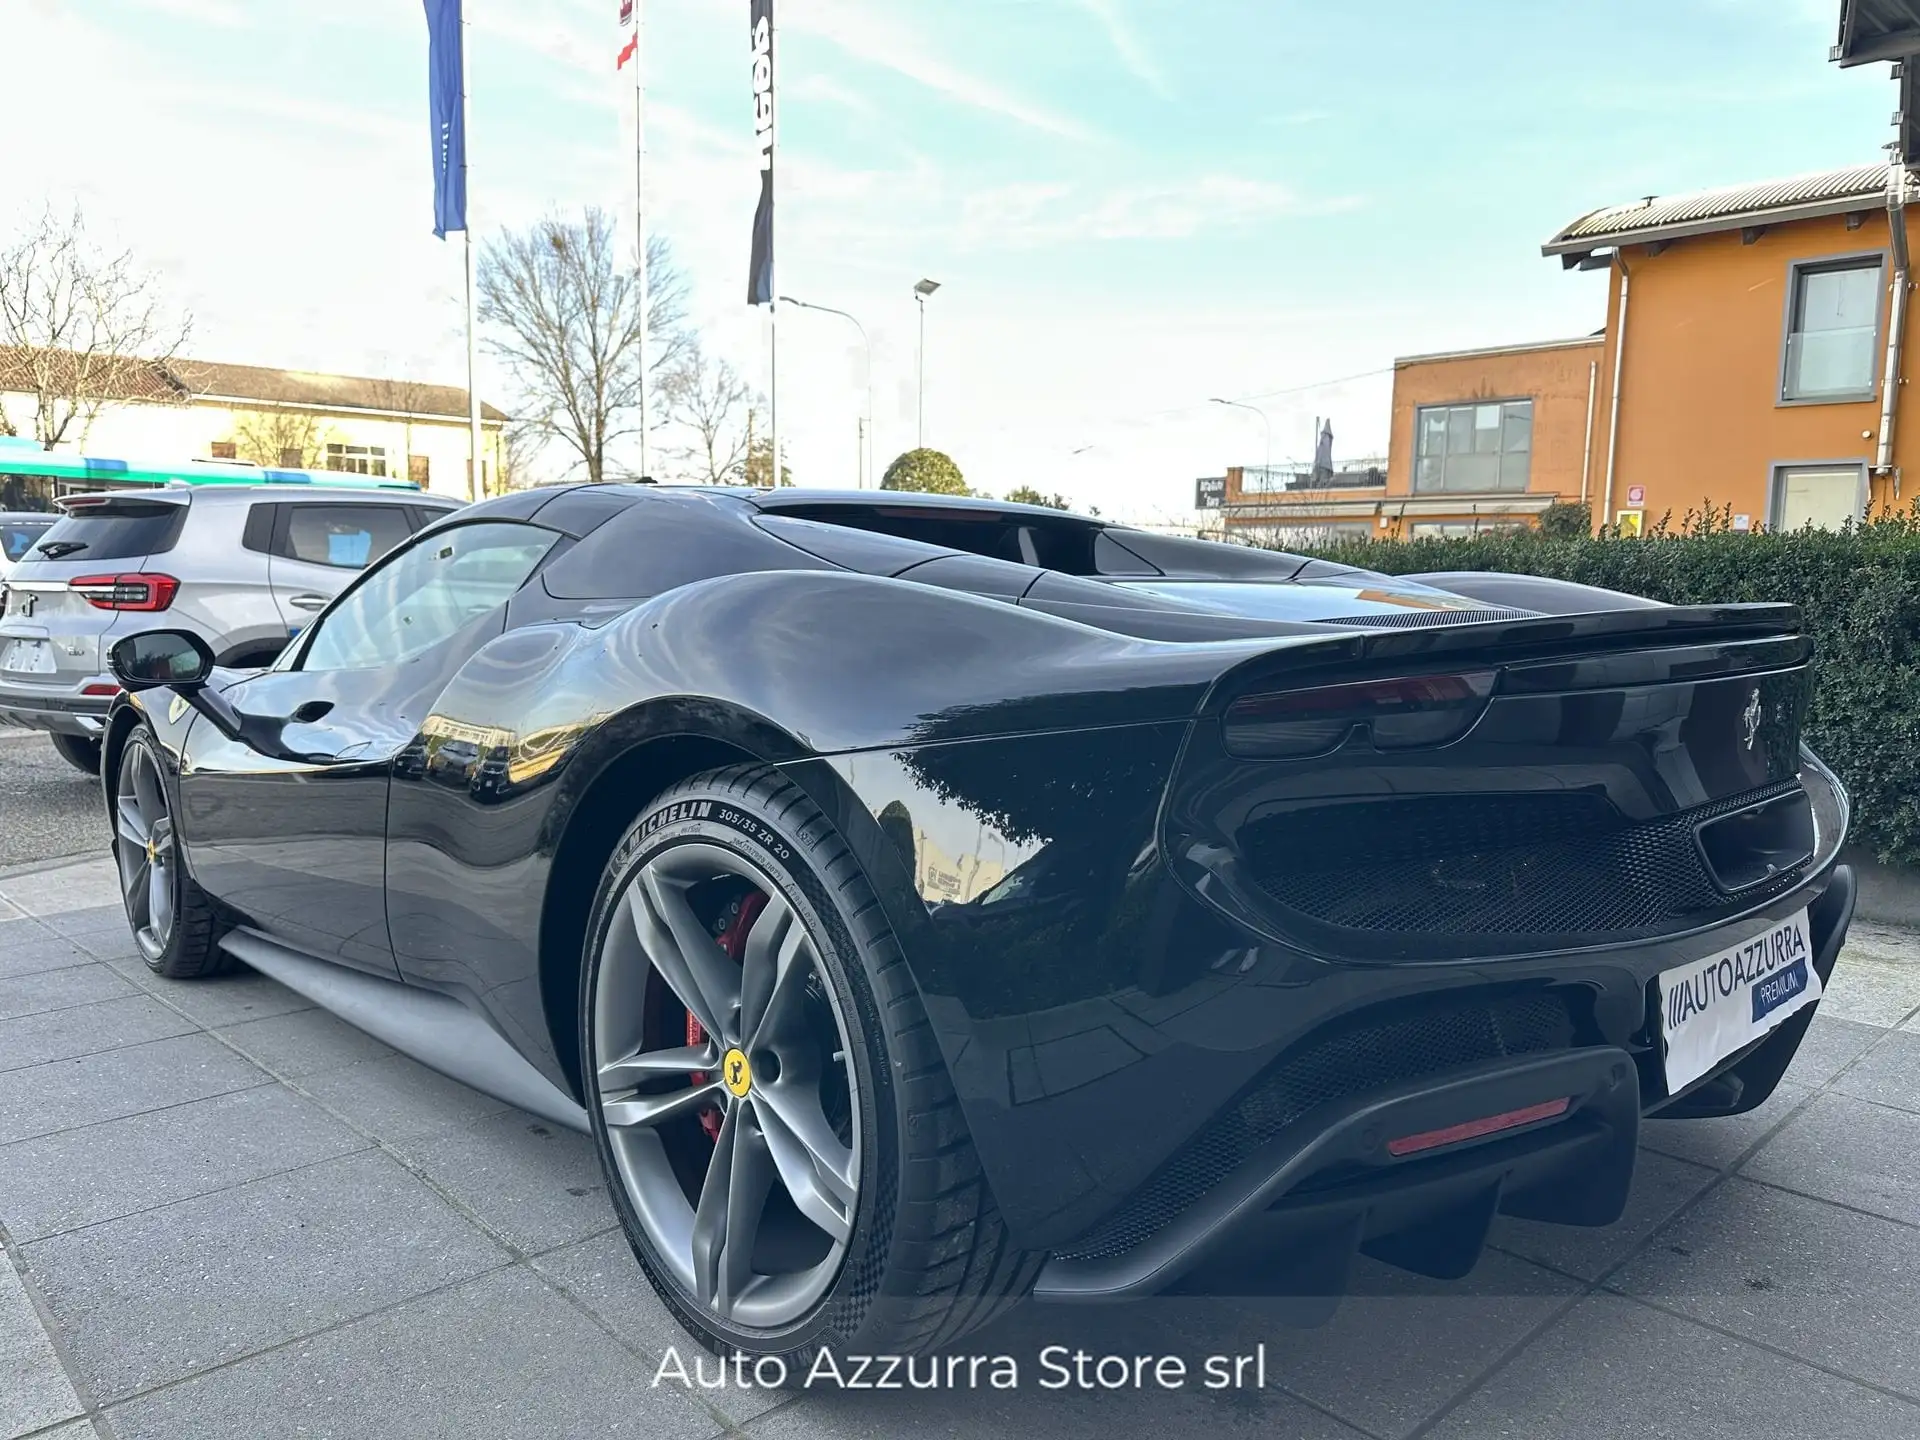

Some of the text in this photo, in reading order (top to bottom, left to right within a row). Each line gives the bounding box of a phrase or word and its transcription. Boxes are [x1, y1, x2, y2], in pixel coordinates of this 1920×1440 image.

[629, 802, 712, 851] MICHELIN
[718, 808, 790, 860] 305/35 ZR 20
[1760, 970, 1799, 1005] PREMIUM
